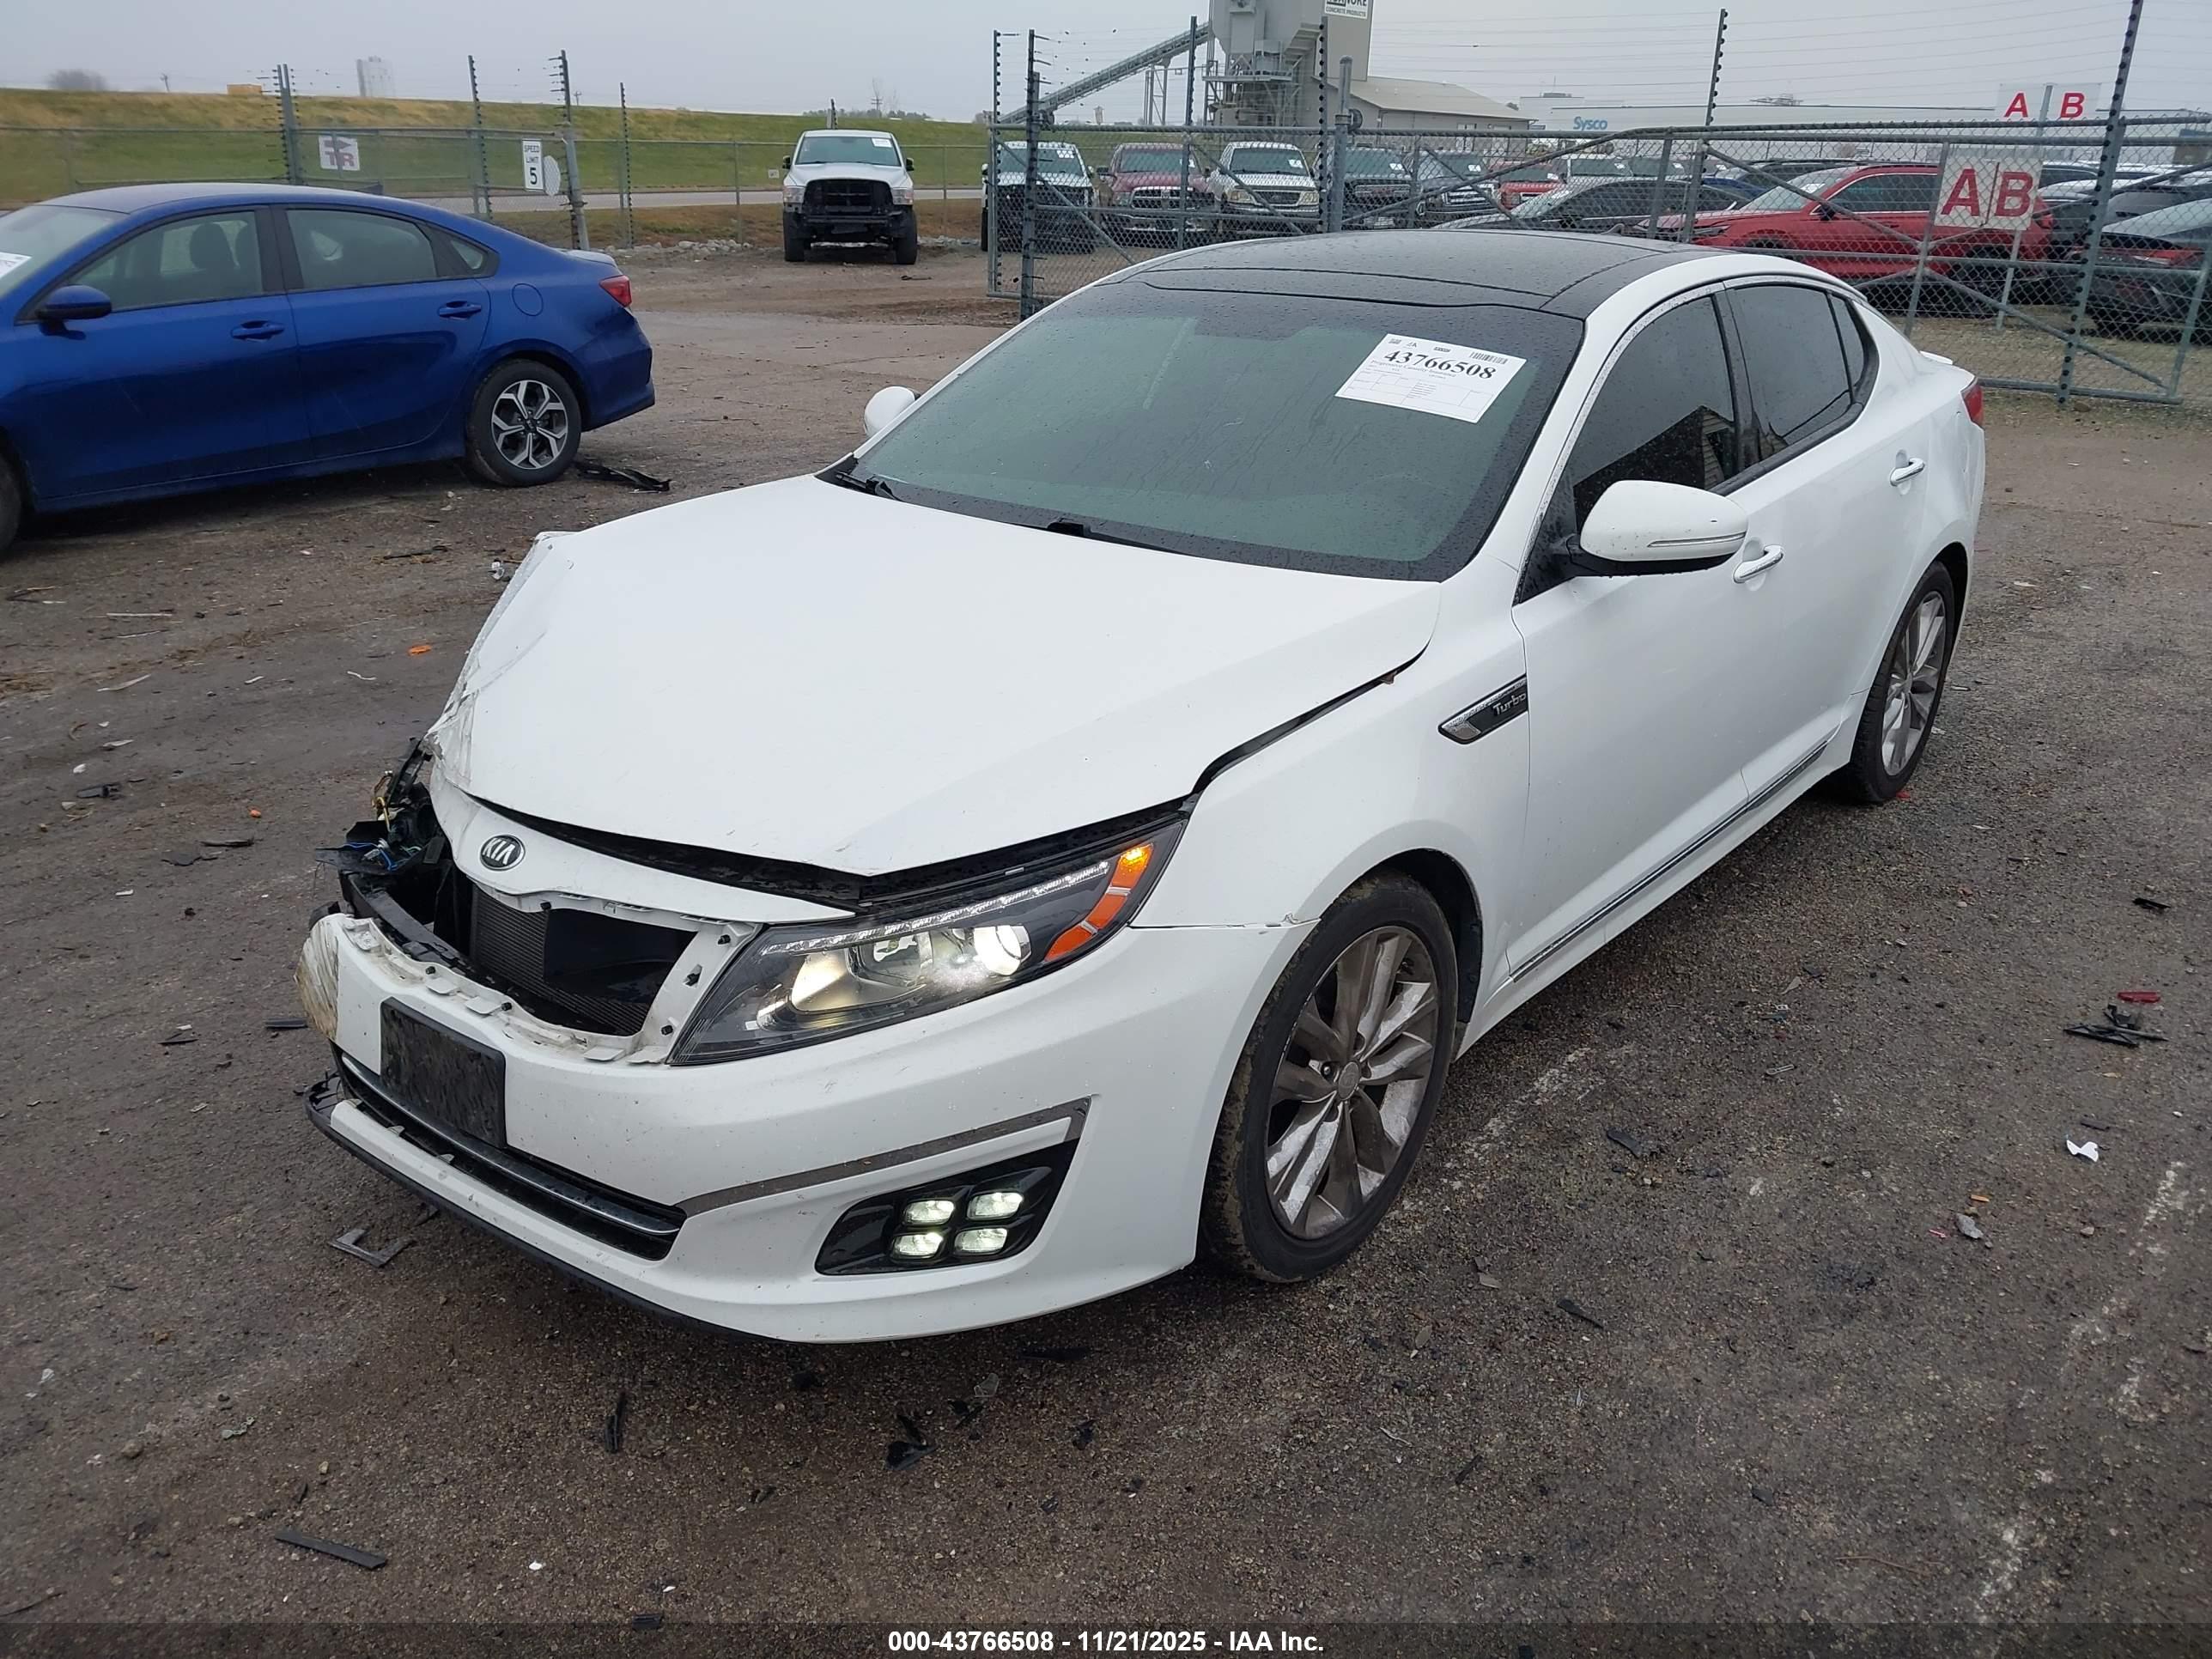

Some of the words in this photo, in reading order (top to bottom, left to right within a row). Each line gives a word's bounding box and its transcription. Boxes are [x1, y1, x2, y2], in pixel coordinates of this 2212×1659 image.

[2003, 92, 2028, 118] A
[2060, 92, 2085, 118] B
[1573, 116, 1608, 131] Sysco
[524, 144, 540, 153] SPEED
[529, 167, 538, 185] 5
[1941, 168, 1980, 216] A
[1994, 171, 2033, 217] B
[1383, 349, 1498, 380] 43766508
[1492, 692, 1527, 715] Turbo
